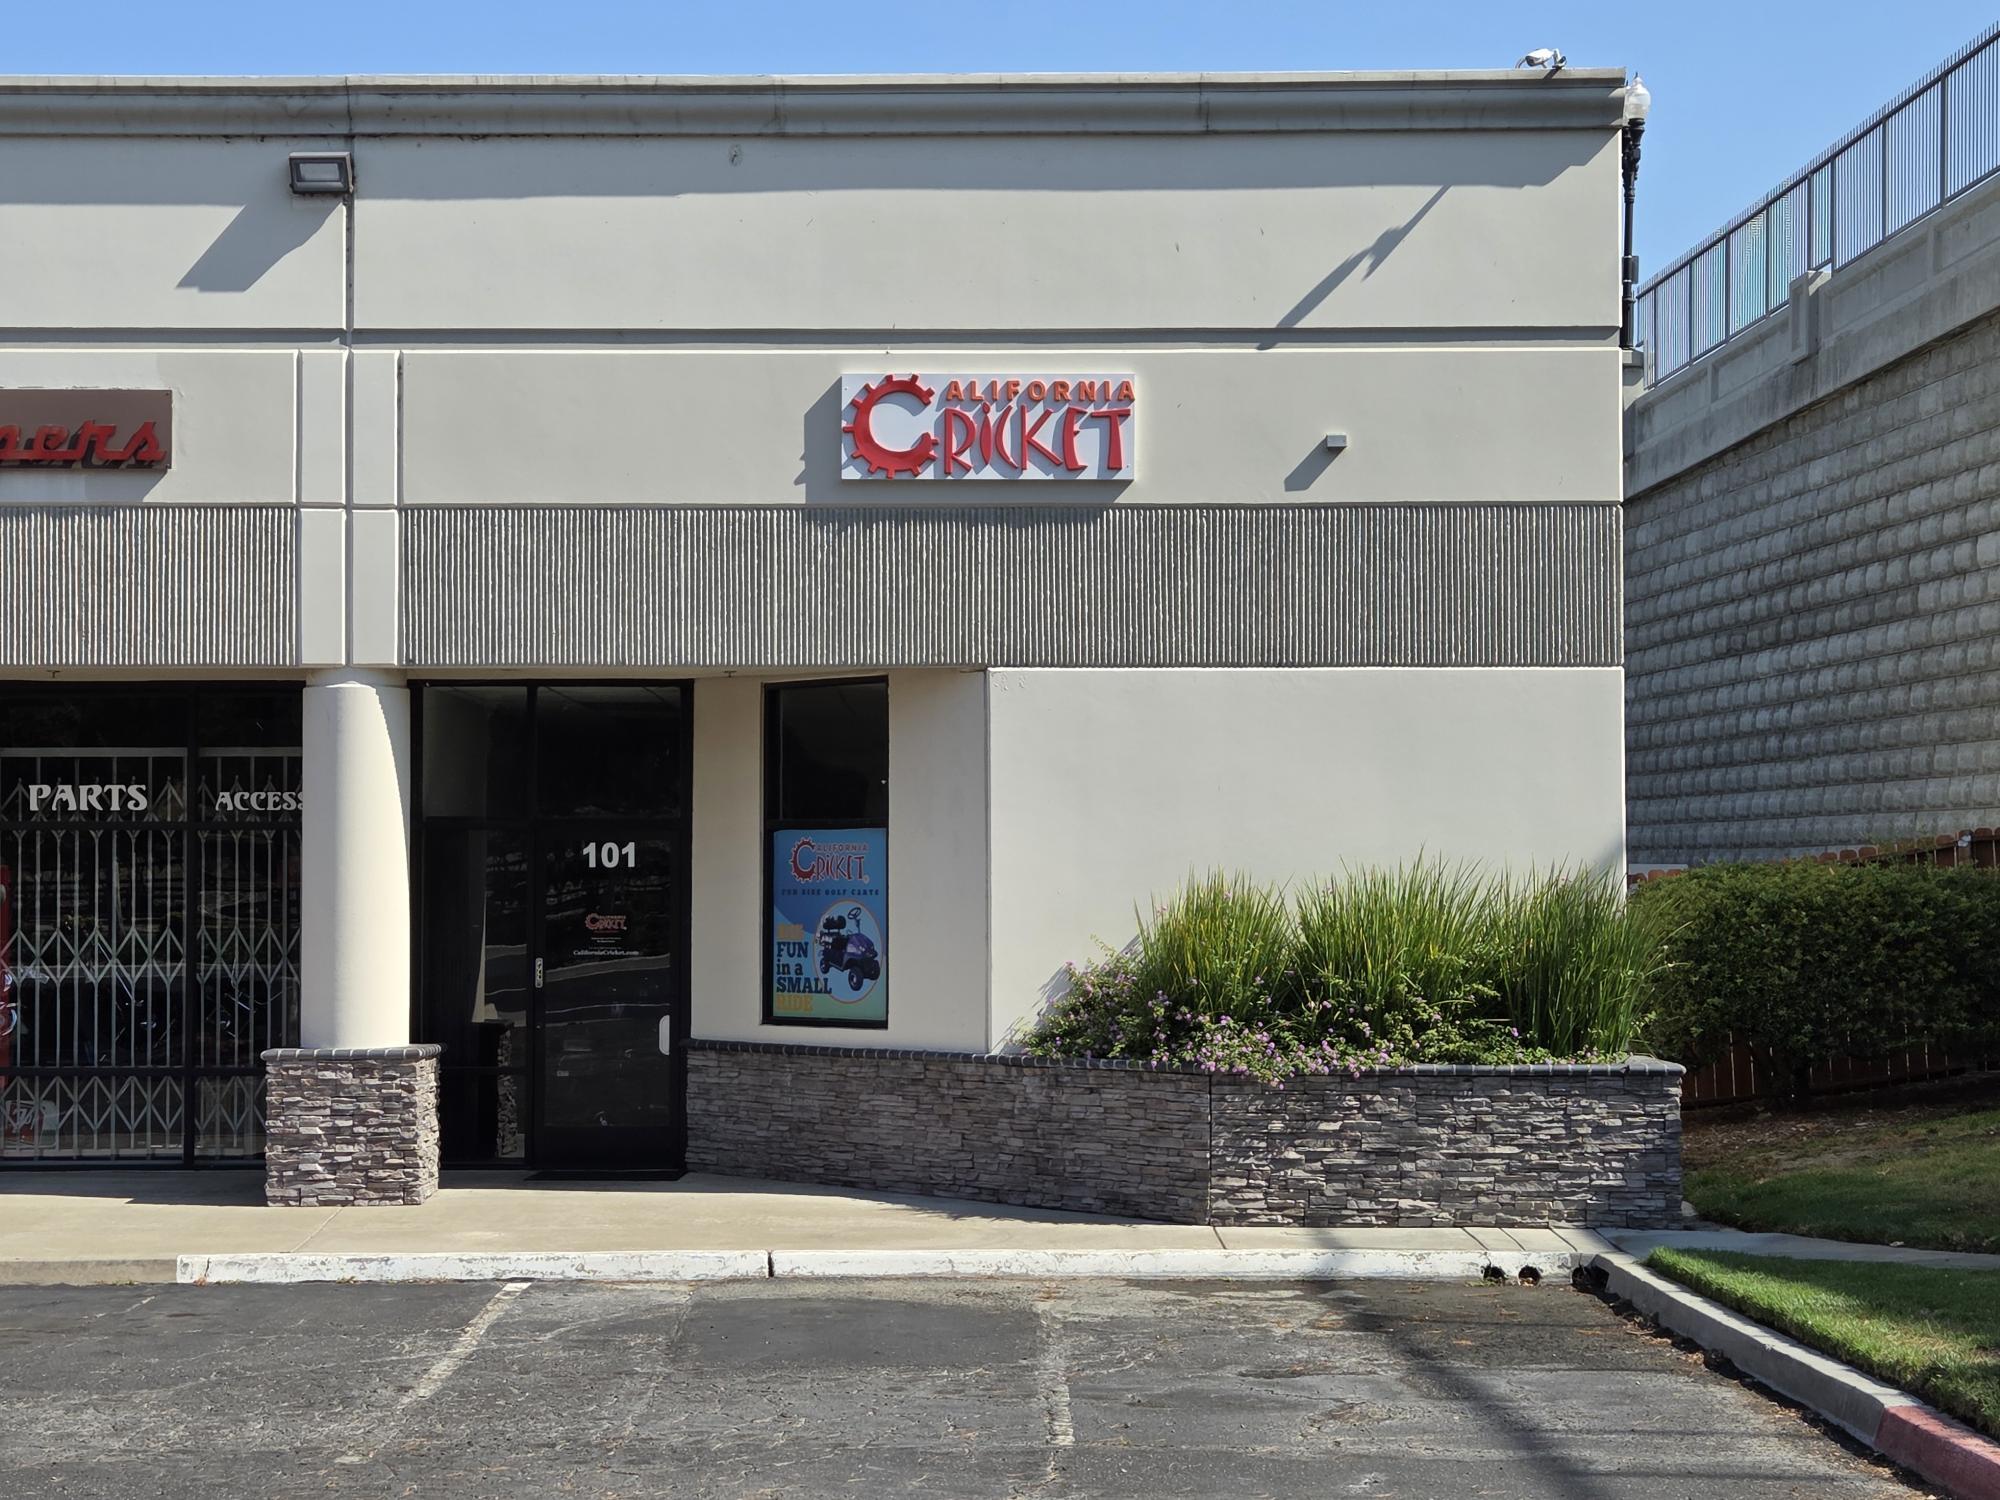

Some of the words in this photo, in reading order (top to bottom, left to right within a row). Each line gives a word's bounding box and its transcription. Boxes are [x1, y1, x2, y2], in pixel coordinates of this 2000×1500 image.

[28, 784, 148, 811] PARTS
[582, 841, 636, 868] 101
[776, 941, 809, 958] FUN
[776, 959, 791, 975] in
[794, 962, 803, 976] a
[776, 976, 833, 994] SMALL
